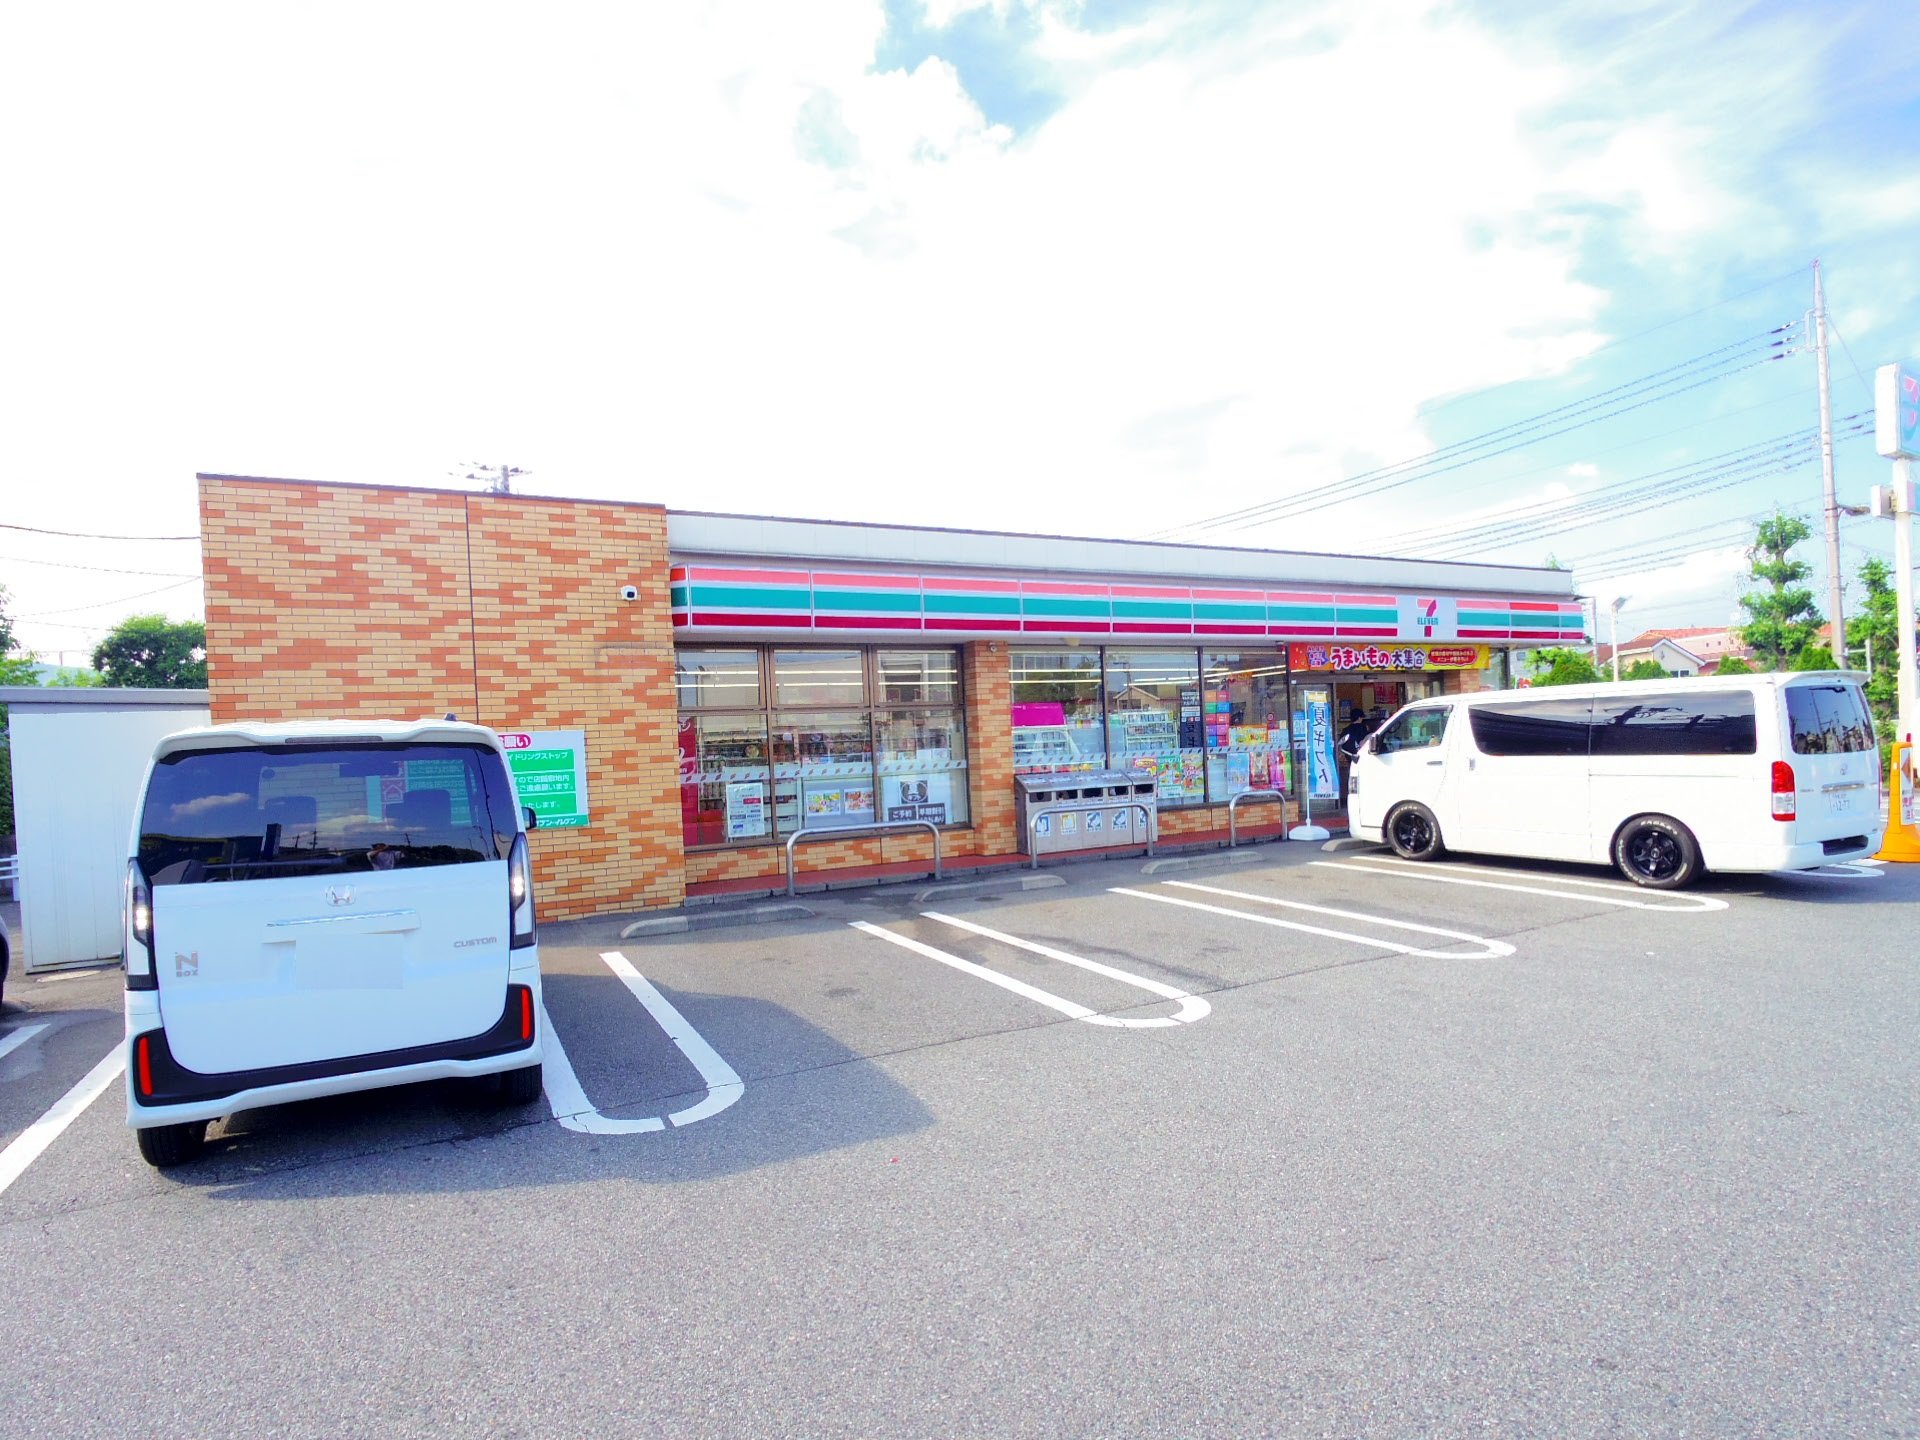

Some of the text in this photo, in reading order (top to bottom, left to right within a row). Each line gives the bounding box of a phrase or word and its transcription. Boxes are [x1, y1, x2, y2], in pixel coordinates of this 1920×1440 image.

[1416, 599, 1438, 638] 7
[1331, 646, 1425, 670] うまいもの大集合
[500, 735, 529, 748] 願い
[453, 936, 497, 948] CUSTOM
[175, 951, 199, 970] N
